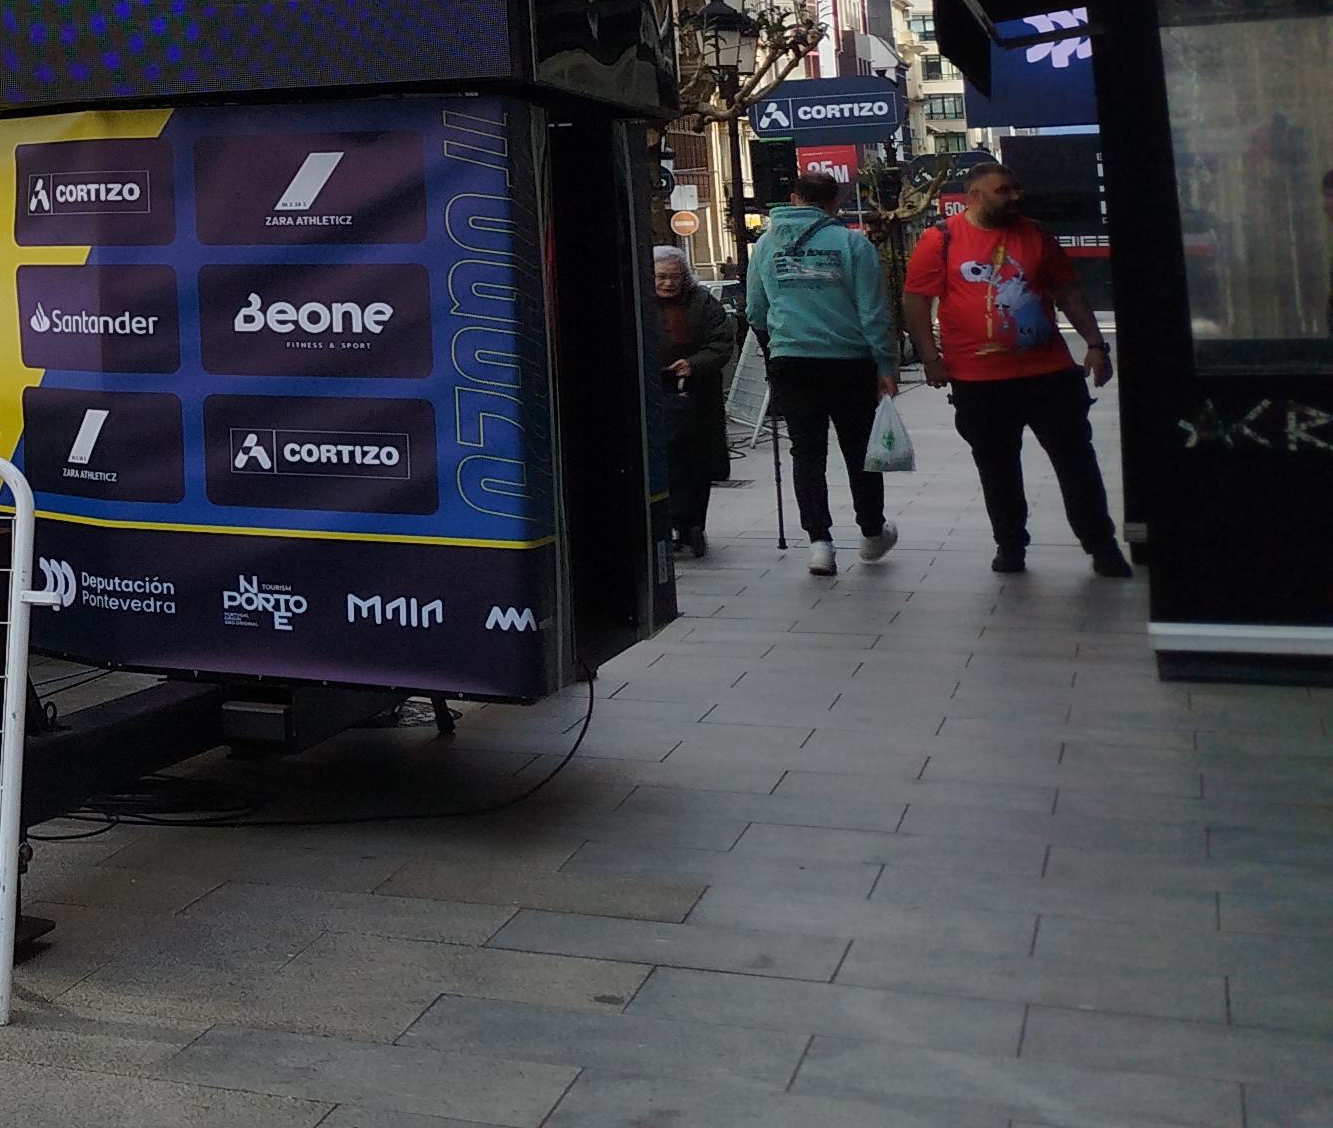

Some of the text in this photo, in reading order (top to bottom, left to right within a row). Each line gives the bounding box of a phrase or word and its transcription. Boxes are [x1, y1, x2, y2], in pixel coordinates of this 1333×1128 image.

[798, 101, 888, 120] CORTIZO
[56, 183, 141, 202] CORTIZO
[265, 215, 352, 226] ZARA ATHLETICZ
[52, 310, 158, 334] Santander
[234, 292, 394, 334] Beone
[284, 443, 400, 466] CORTIZO
[62, 467, 117, 482] ZARA ATHLETICZ
[82, 571, 175, 595] Deputación
[261, 583, 291, 591] TOURISM
[82, 590, 176, 614] Pontevedra
